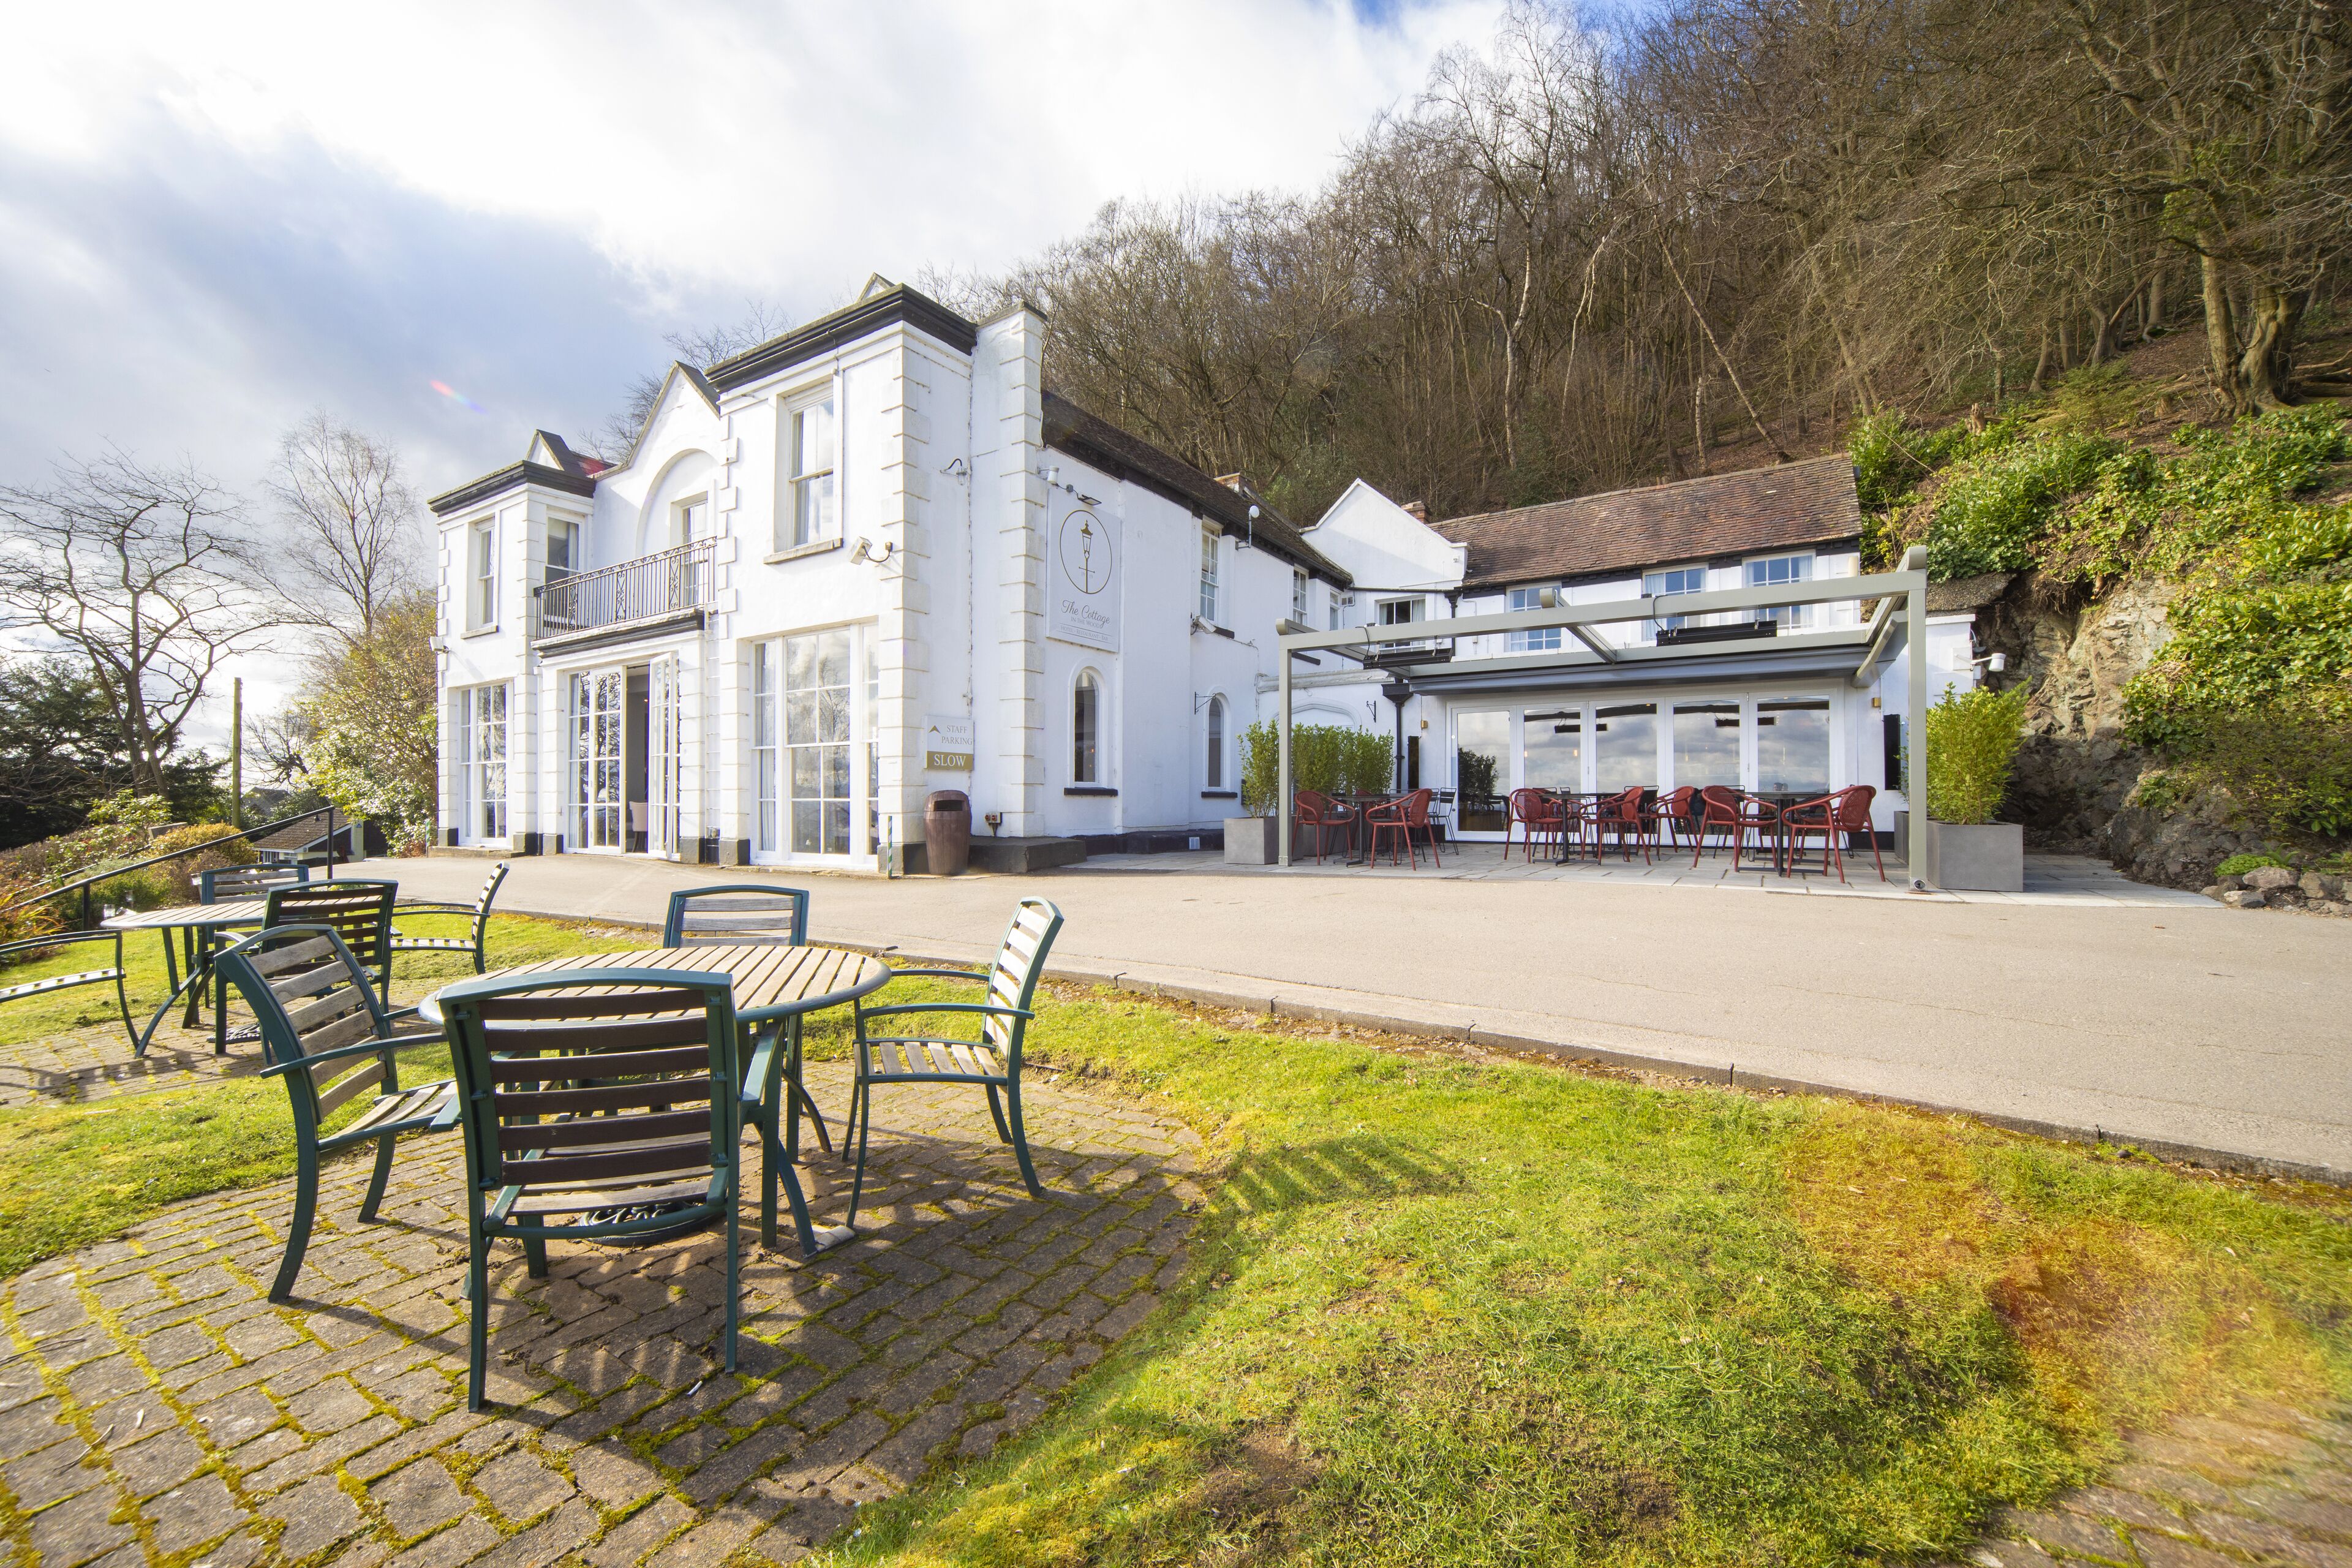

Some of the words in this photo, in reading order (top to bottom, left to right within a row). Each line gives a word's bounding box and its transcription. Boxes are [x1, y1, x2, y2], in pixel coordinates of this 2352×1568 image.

[1061, 600, 1078, 615] The
[1082, 605, 1110, 628] Cottage
[1087, 620, 1100, 628] WOOD
[941, 736, 972, 745] PARKING
[933, 754, 966, 766] SLOW
